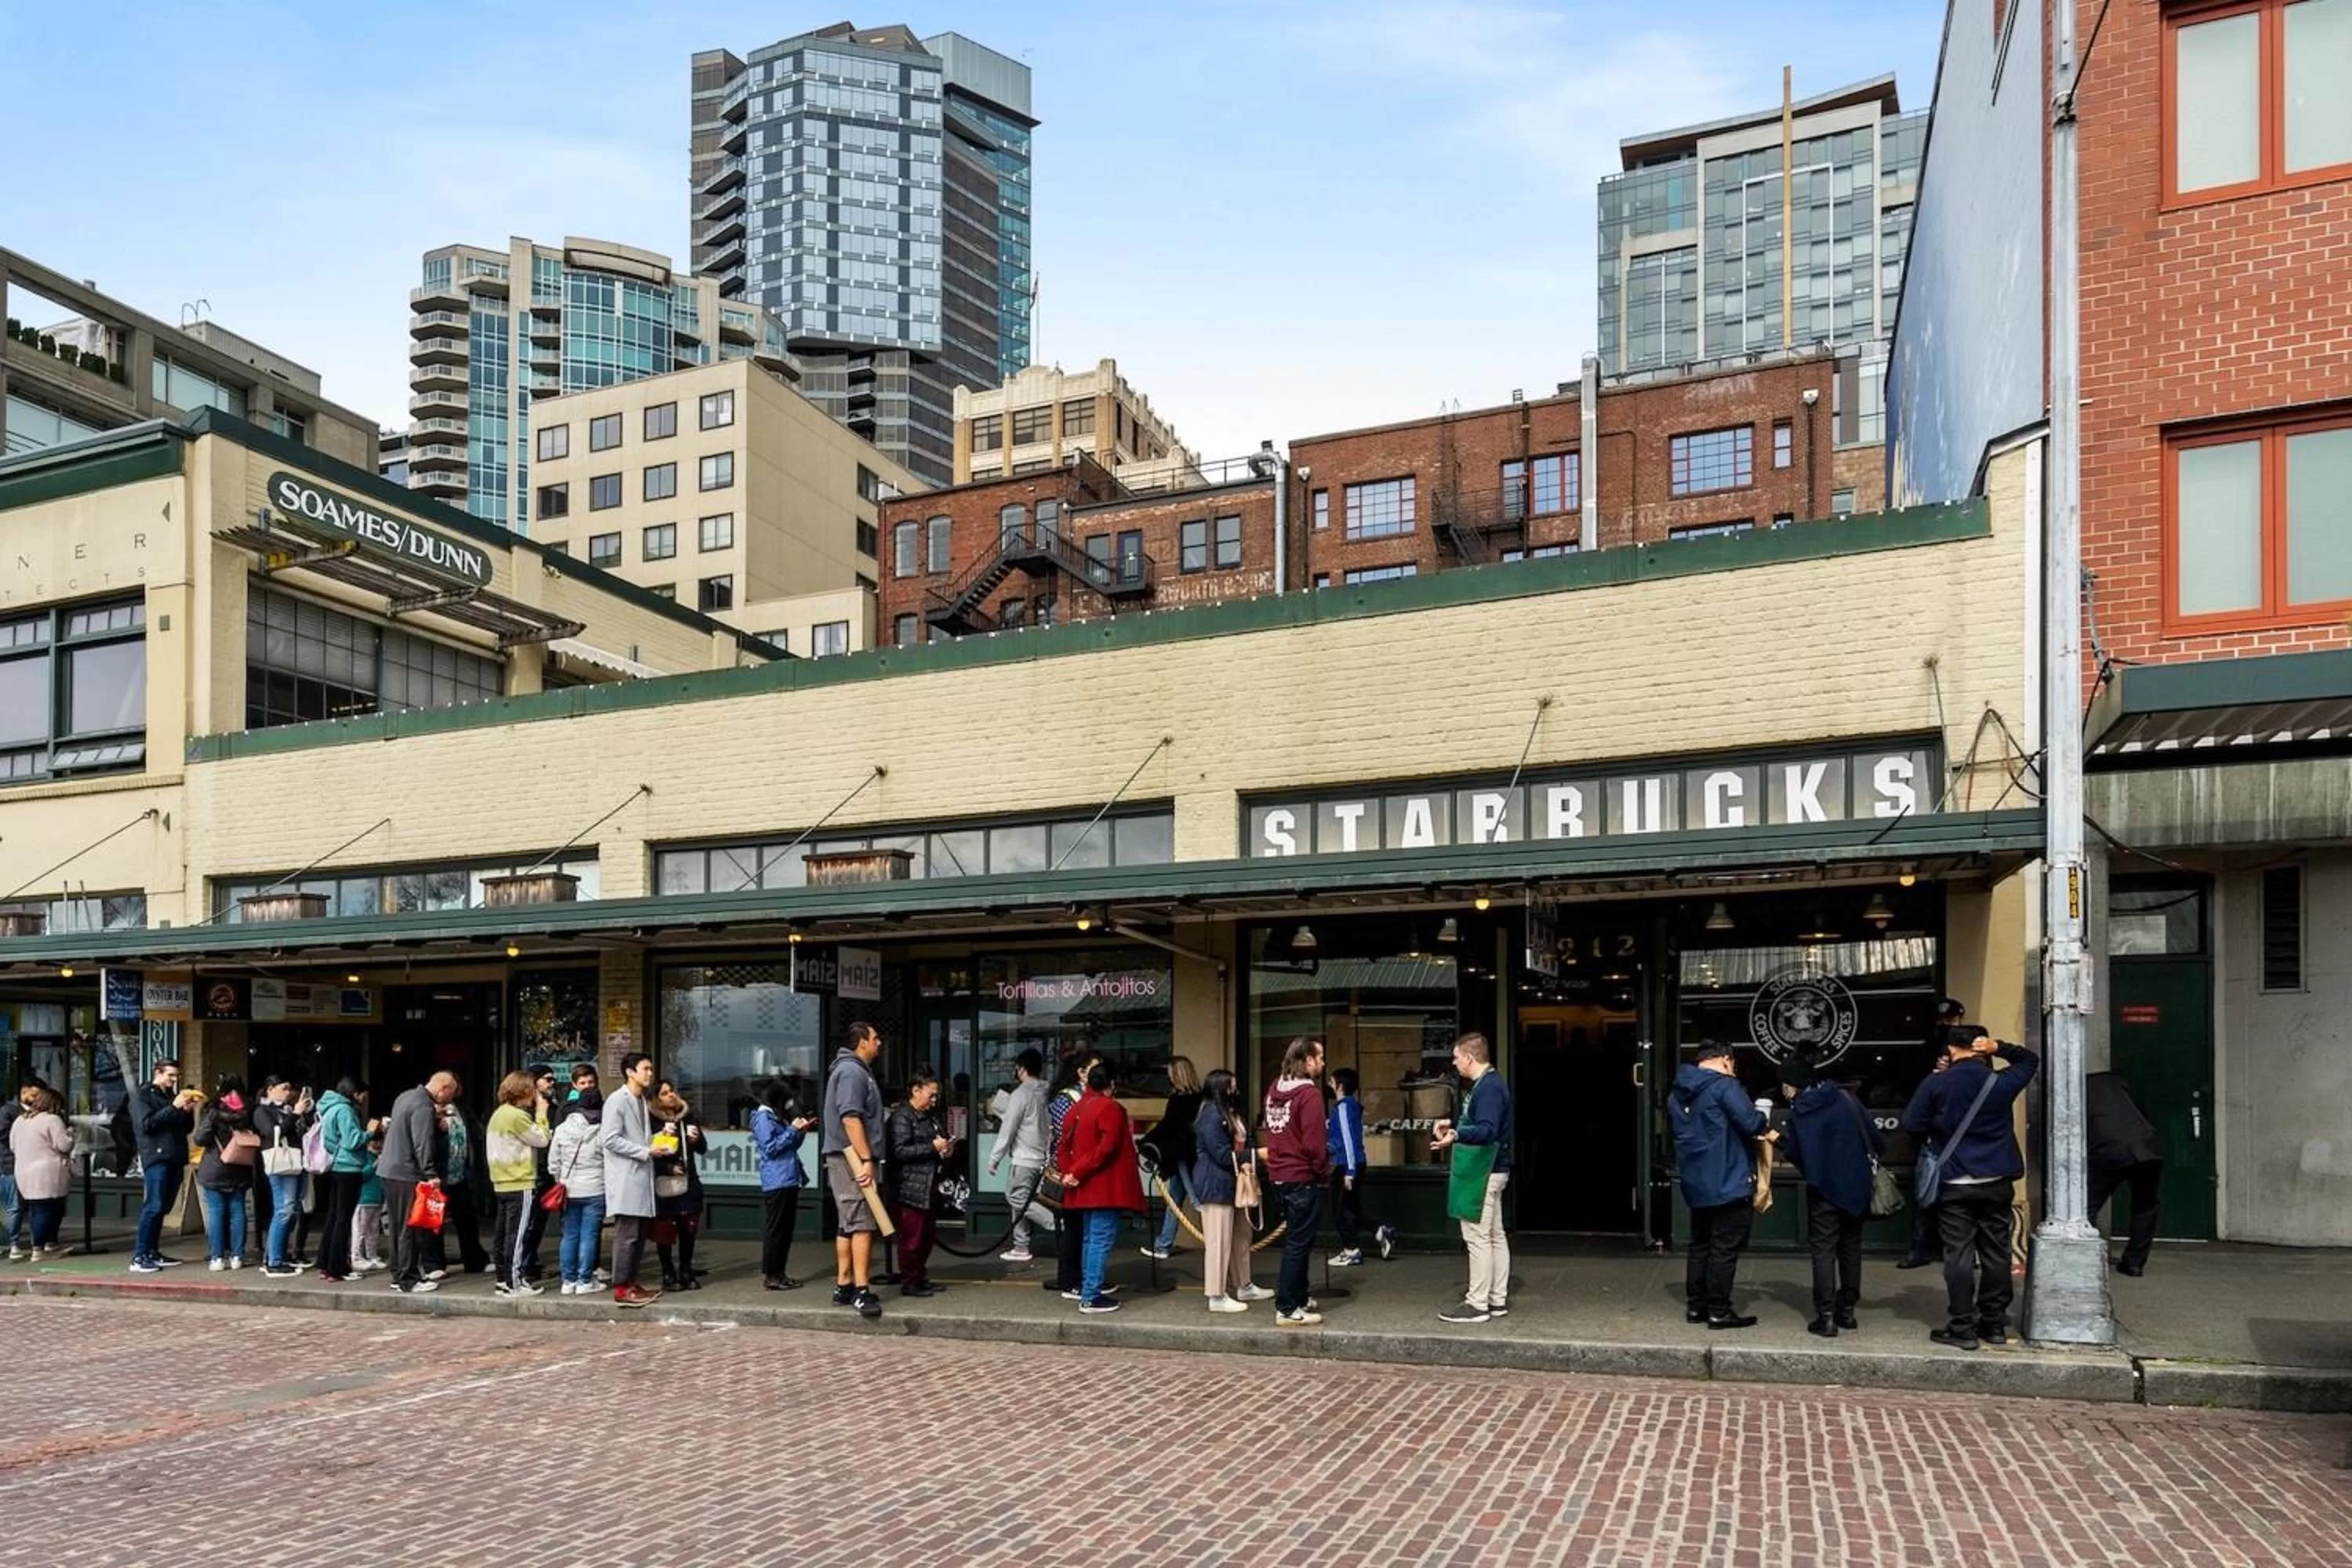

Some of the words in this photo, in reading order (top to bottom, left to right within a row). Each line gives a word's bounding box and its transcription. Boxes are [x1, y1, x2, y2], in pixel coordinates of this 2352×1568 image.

[278, 480, 482, 579] SOAMES/DUNN
[1264, 757, 1915, 857] STARBUCKS
[996, 979, 1056, 1000] Tortillas
[1061, 980, 1073, 996] &
[1080, 977, 1155, 999] Antojitos
[1754, 1013, 1780, 1055] COFFEE
[1831, 1011, 1853, 1050] SPICES
[1389, 1119, 1437, 1130] CAFF
[701, 1135, 760, 1172] MAÍ
